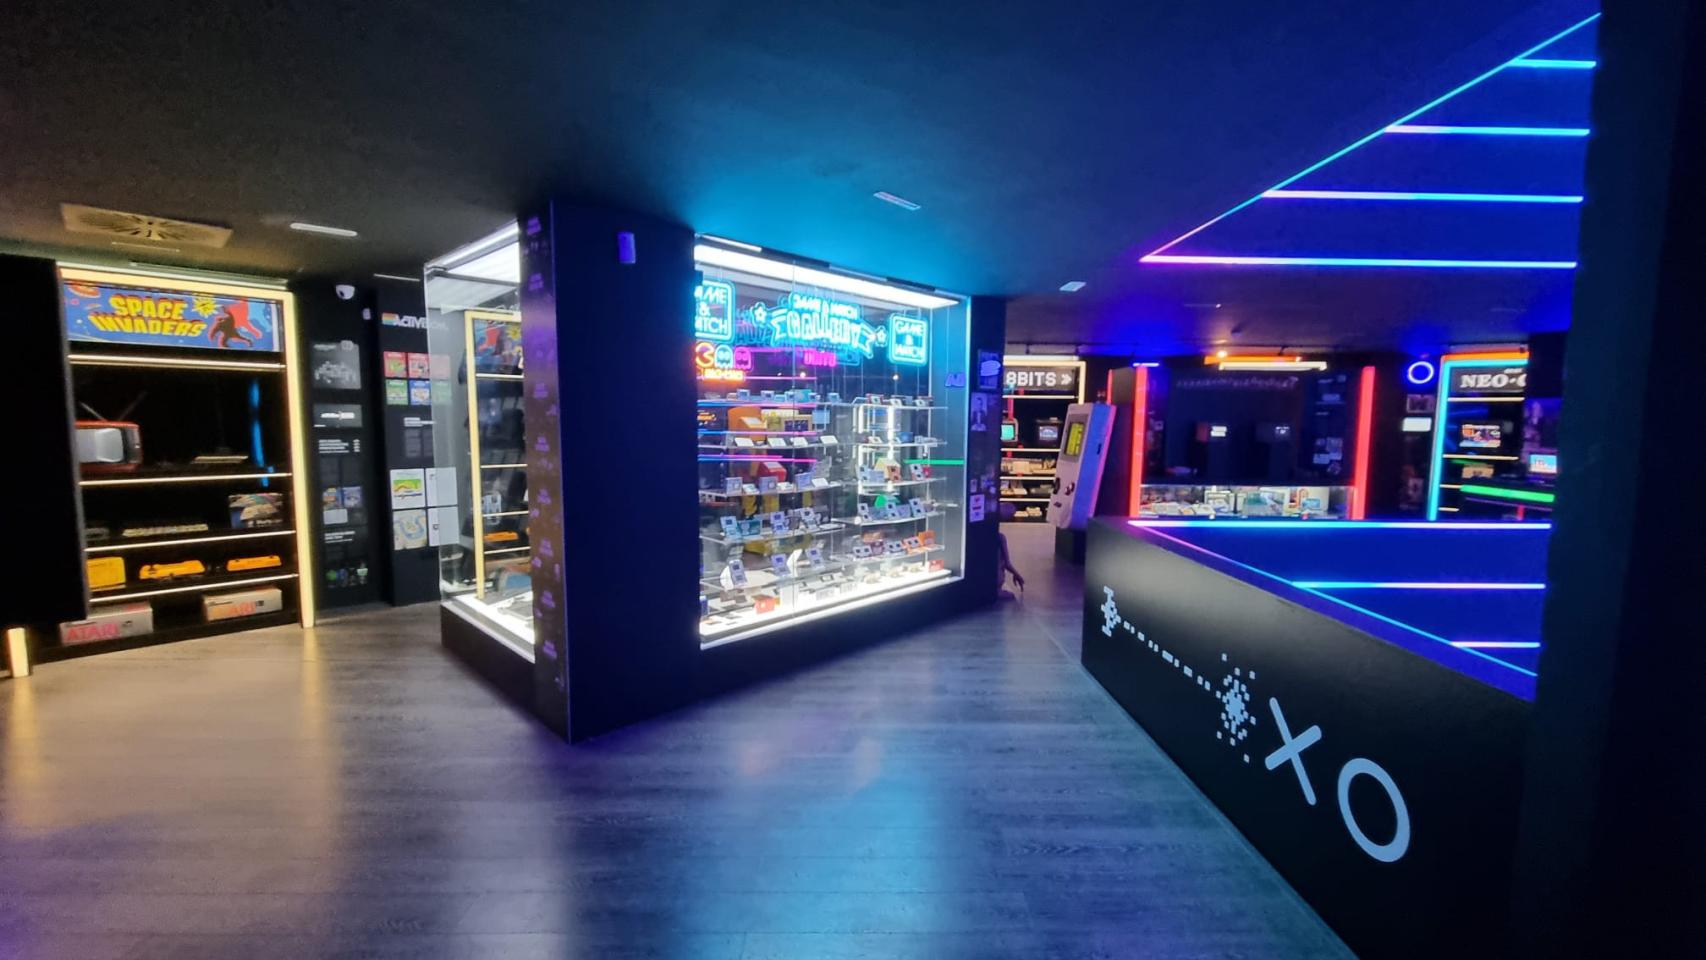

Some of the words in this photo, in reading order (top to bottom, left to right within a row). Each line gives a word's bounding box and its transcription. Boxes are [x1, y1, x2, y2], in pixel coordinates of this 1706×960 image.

[693, 285, 727, 304] AME
[108, 293, 188, 320] SPACE
[88, 311, 208, 337] INVADERS
[693, 312, 727, 335] ATCH
[895, 320, 924, 336] GAME
[1006, 371, 1057, 387] 8BITS
